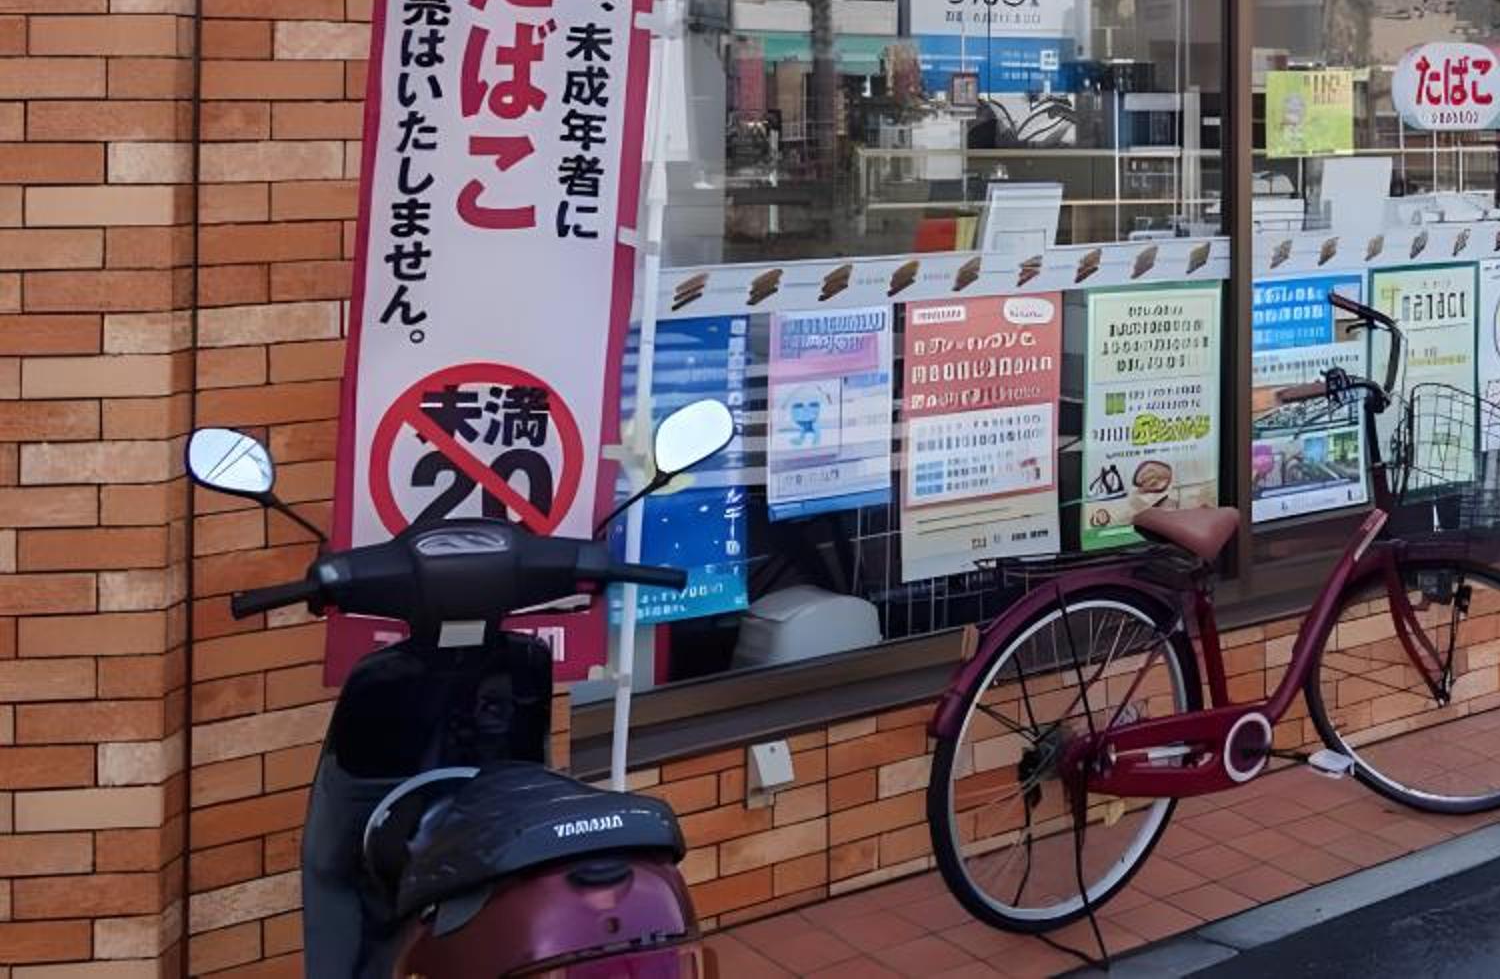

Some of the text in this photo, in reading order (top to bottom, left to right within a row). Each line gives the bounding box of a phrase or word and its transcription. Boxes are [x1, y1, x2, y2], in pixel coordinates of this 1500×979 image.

[1415, 55, 1493, 107] たばこ
[417, 385, 550, 447] 未満
[411, 448, 554, 525] 20
